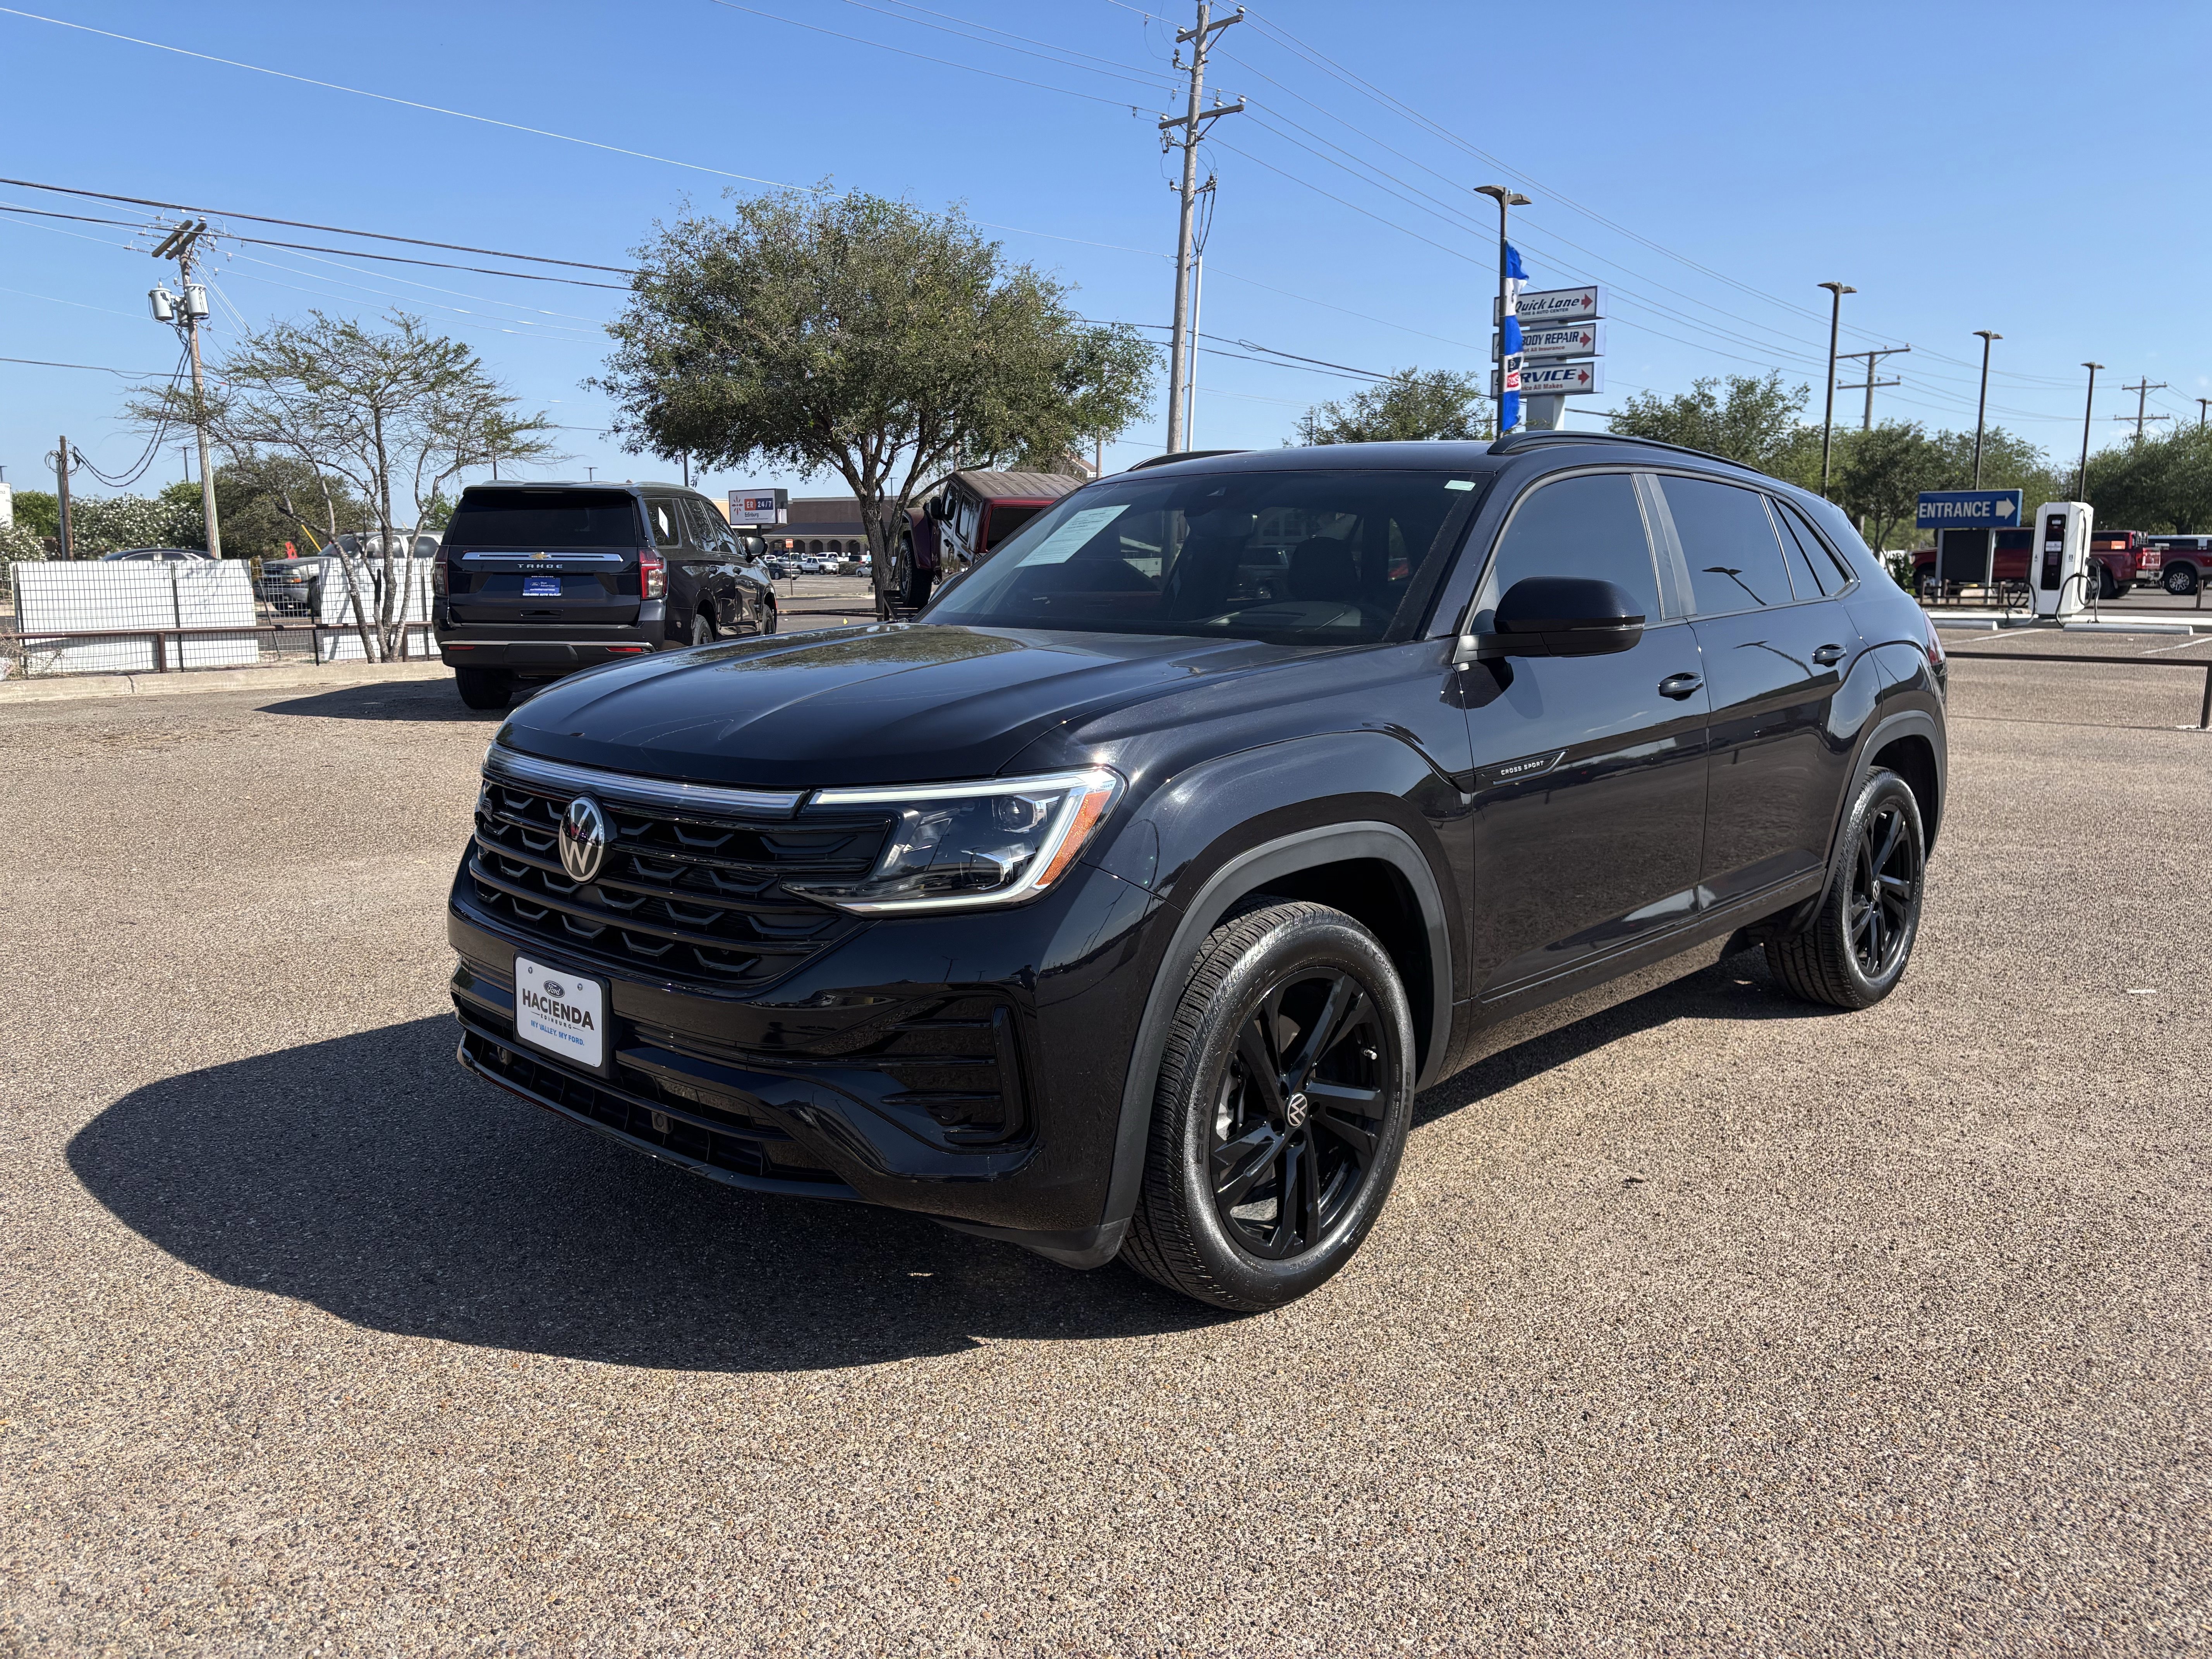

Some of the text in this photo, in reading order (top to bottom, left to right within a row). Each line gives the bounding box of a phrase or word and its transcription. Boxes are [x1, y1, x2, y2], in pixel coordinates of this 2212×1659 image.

[1515, 297, 1580, 313] Quick Lane
[1545, 331, 1579, 344] REPAIR
[1919, 501, 1991, 518] ENTRANCE
[1501, 761, 1544, 775] CROSS SPORT
[547, 983, 560, 995] Ford
[522, 988, 594, 1030] HACIENDA
[541, 1014, 572, 1029] EDINBURG
[531, 1020, 584, 1046] MY VALLEY. MY FORD.
